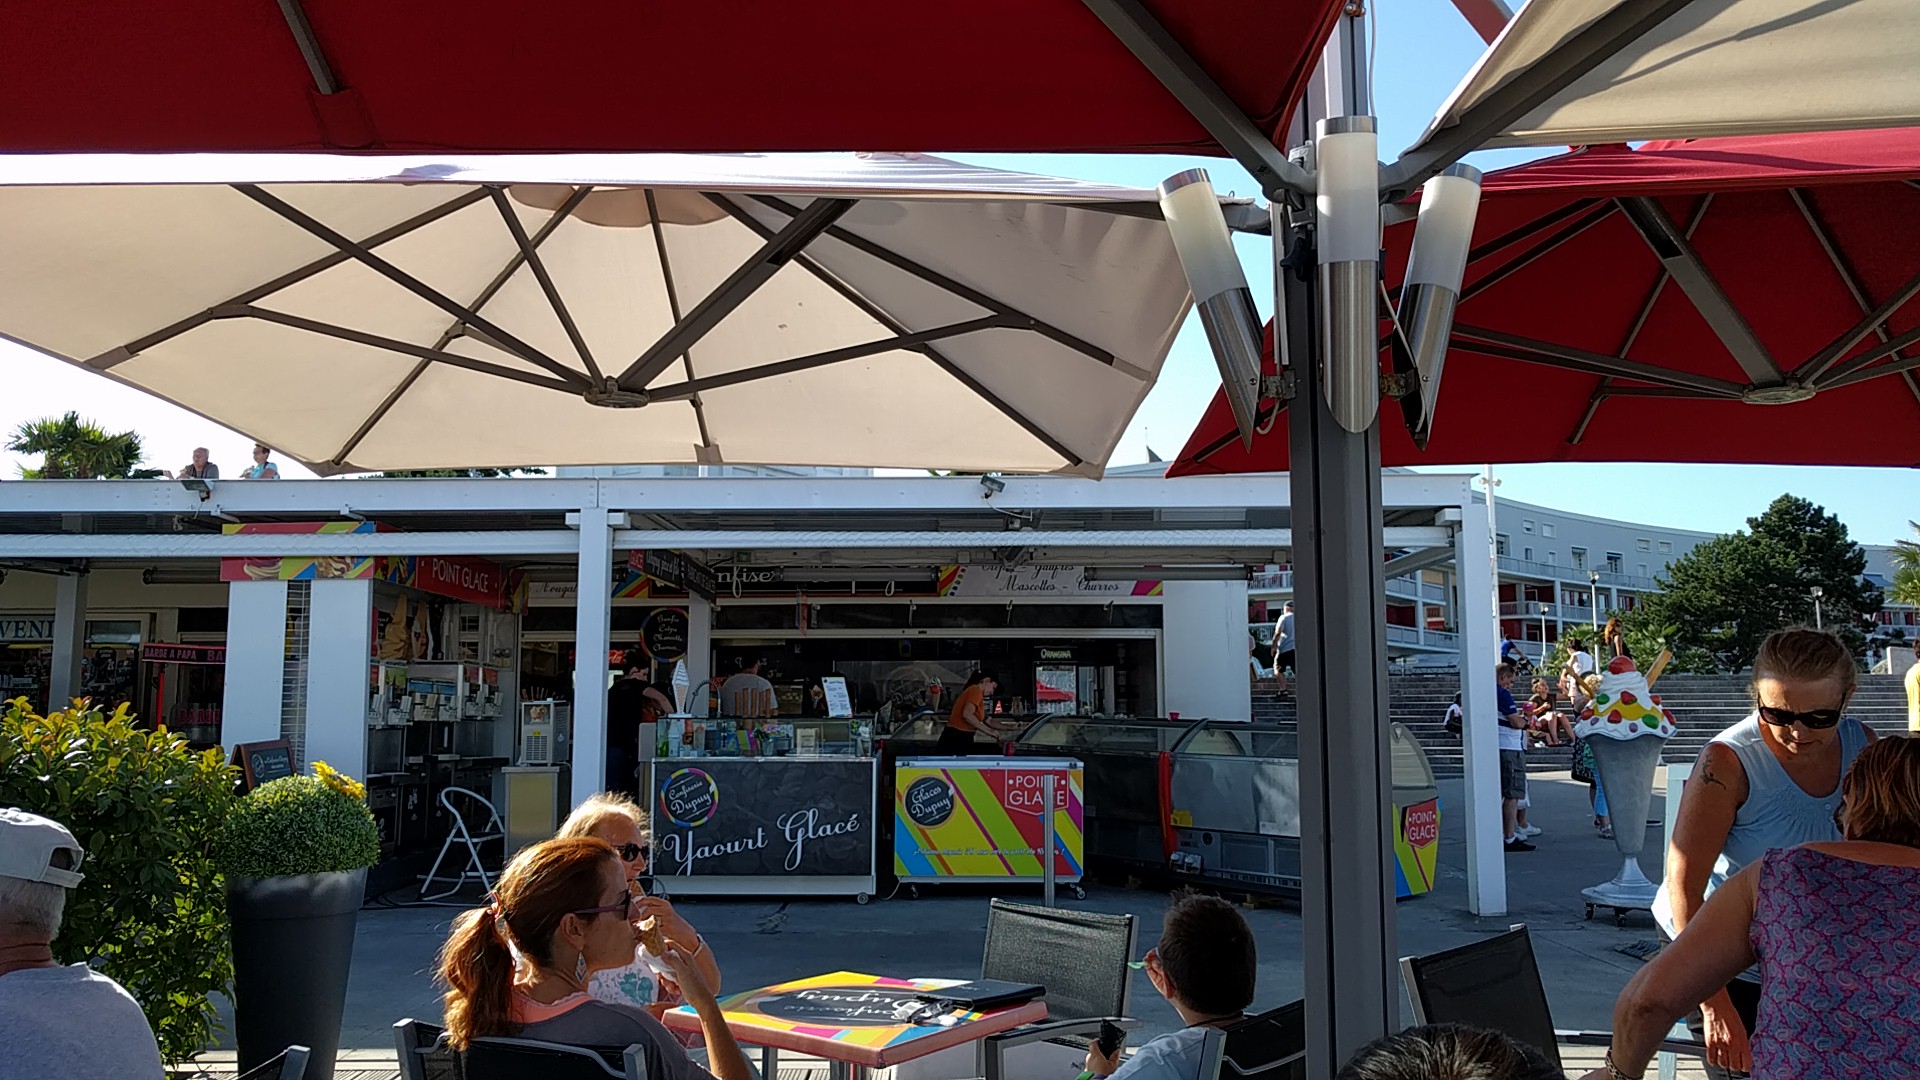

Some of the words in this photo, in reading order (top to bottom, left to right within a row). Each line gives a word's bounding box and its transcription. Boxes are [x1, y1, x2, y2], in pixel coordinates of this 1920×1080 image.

[432, 557, 460, 586] POINT
[461, 566, 490, 593] GLACE
[999, 575, 1057, 591] Mascottes
[1076, 574, 1119, 591] Churros
[144, 647, 168, 659] BARBE
[176, 649, 197, 661] PAPA
[668, 780, 703, 800] Confiserie
[1016, 775, 1060, 788] POIT
[911, 786, 942, 803] Glaces
[1009, 790, 1065, 805] GLAE
[670, 793, 712, 815] Dupuy
[911, 798, 951, 818] Dupuy
[1411, 811, 1433, 824] POINT
[1409, 824, 1435, 841] GLACE
[663, 827, 768, 876] Yaourt
[776, 808, 860, 871] Glacé
